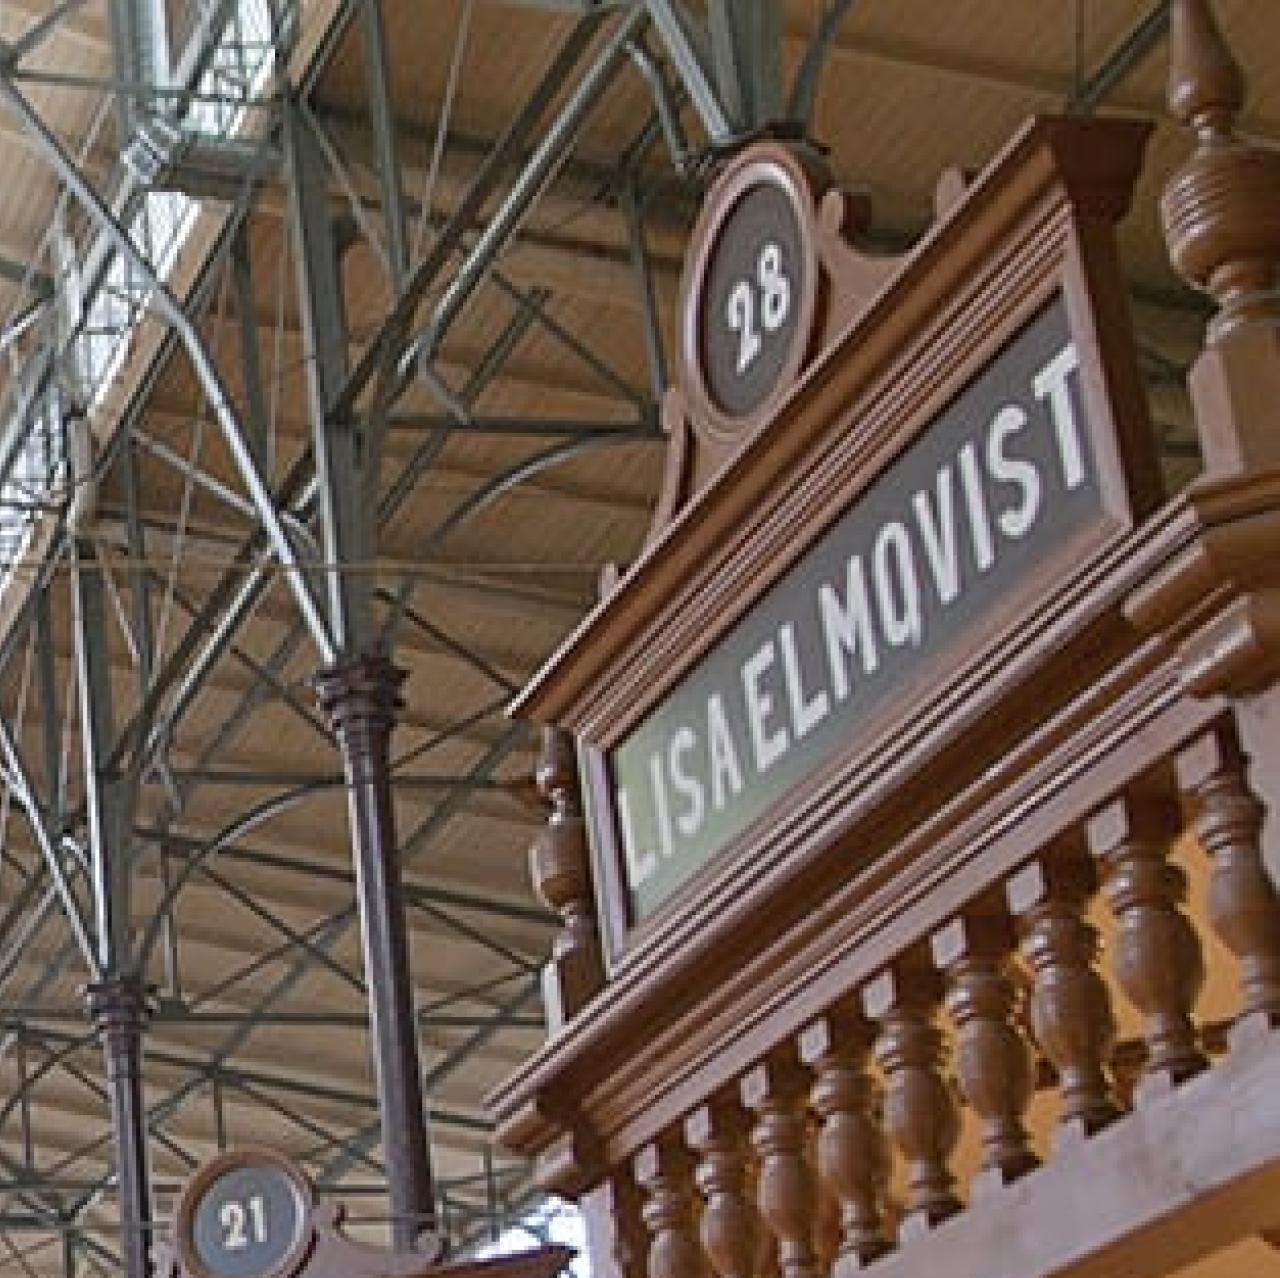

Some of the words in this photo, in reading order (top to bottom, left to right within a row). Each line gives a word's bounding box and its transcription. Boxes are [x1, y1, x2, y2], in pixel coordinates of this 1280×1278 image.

[727, 244, 791, 373] 28
[618, 692, 742, 888] LISA
[742, 342, 1085, 773] ELMQVIST
[217, 1196, 268, 1250] 21
